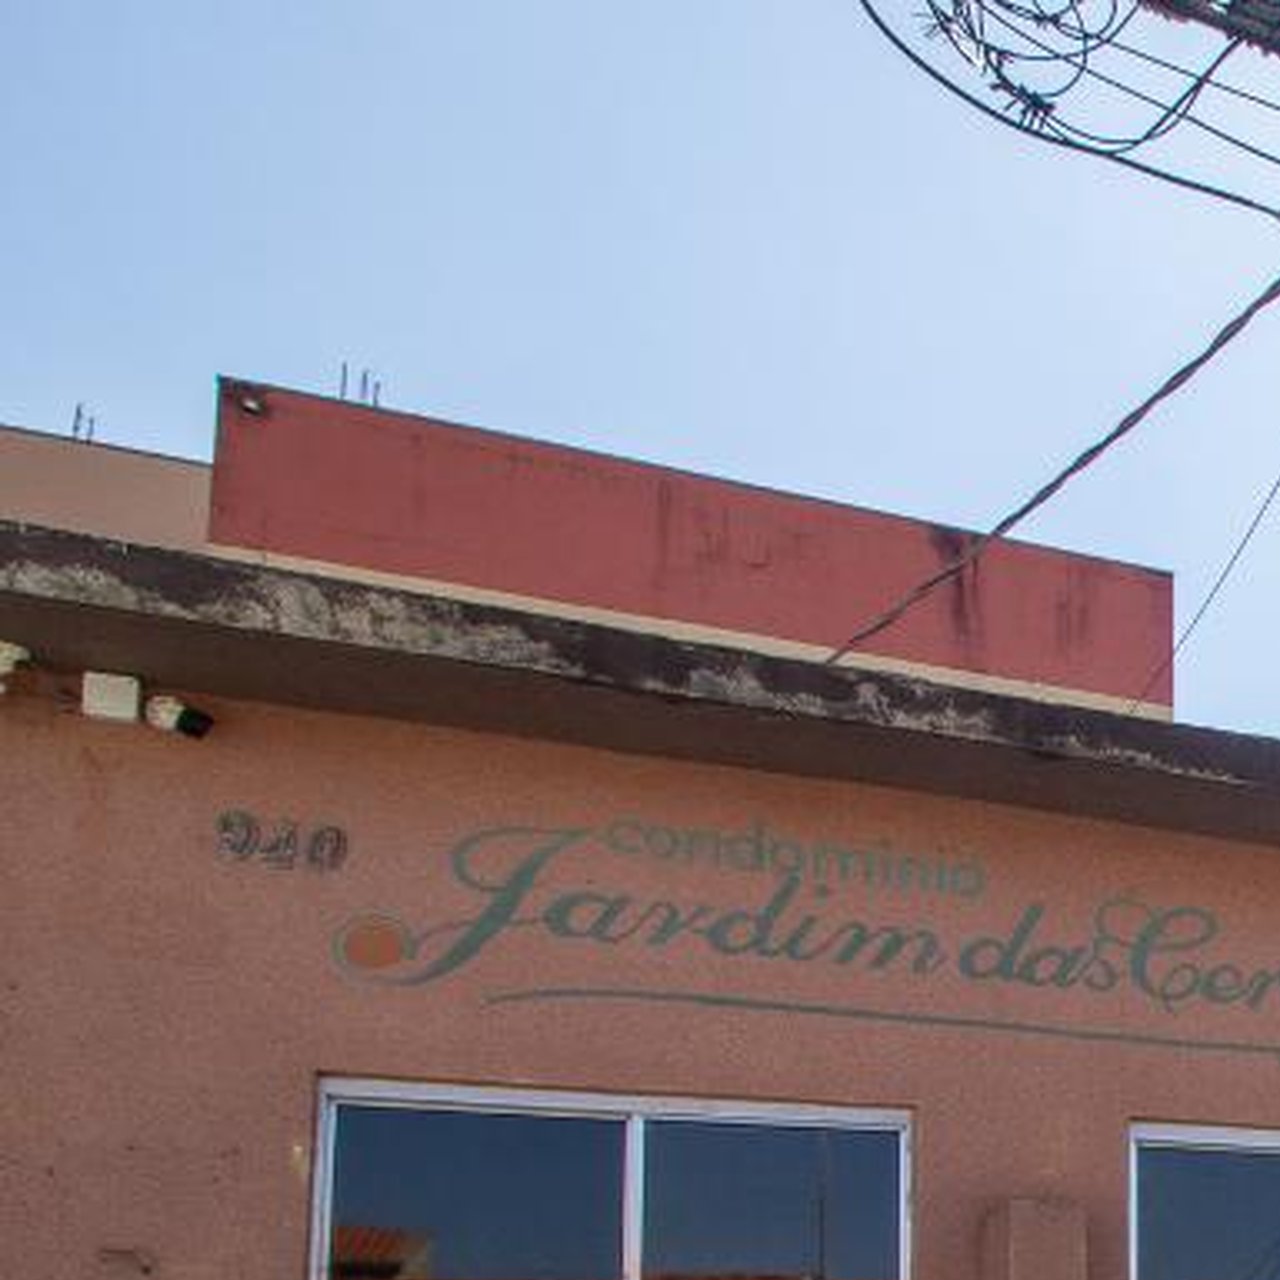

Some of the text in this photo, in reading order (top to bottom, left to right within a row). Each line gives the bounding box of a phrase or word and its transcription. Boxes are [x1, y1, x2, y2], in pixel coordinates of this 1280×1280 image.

[214, 809, 349, 872] 940
[335, 826, 946, 986] Jardim
[958, 903, 1118, 993] das
